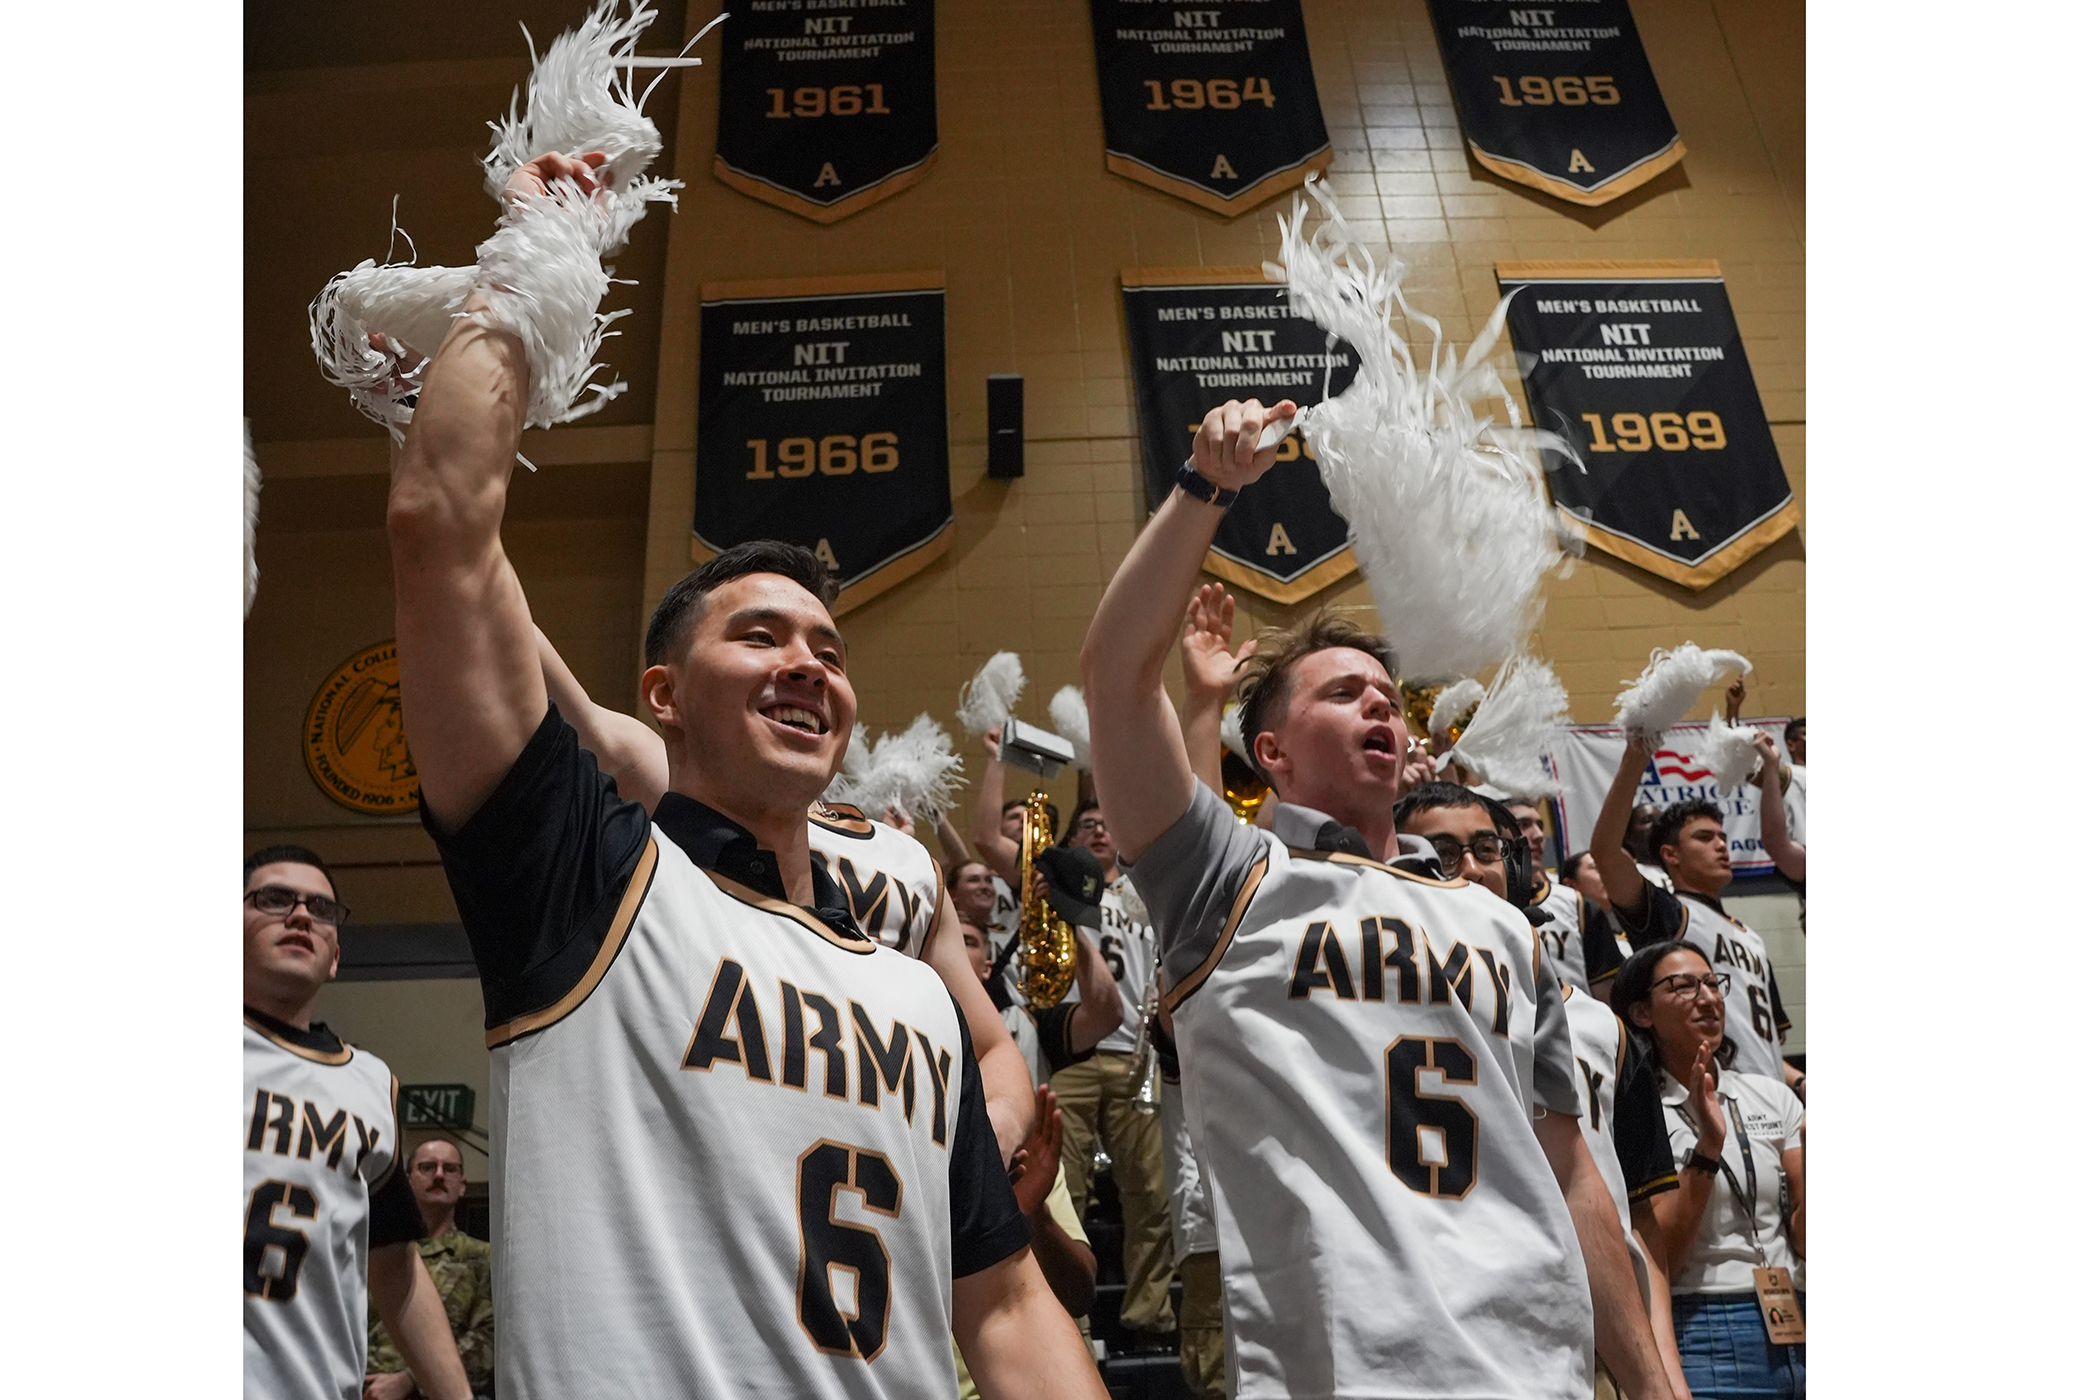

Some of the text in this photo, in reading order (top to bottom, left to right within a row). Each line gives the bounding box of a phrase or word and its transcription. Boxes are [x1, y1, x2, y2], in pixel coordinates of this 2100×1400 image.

[804, 16, 853, 35] NIT
[1173, 10, 1221, 28] NIT
[1508, 9, 1555, 27] NIT
[743, 31, 916, 50] NATIONAL INVITATION
[1116, 27, 1285, 41] NATIONAL INVITATION
[1457, 26, 1621, 39] NATIONAL INVITATION
[776, 46, 881, 62] TOURNAMENT
[1151, 40, 1254, 54] TOURNAMENT
[1492, 40, 1591, 51] TOURNAMENT
[765, 83, 890, 119] 1961
[1143, 77, 1275, 112] 1964
[1492, 75, 1621, 107] 1965
[1209, 153, 1238, 180] A
[1567, 148, 1596, 174] A
[813, 162, 841, 188] A
[1157, 304, 1302, 321] MEN'S BASKETB
[1537, 299, 1702, 314] MEN'S BASKETBALL
[733, 313, 912, 335] MEN'S BASKETBALL
[1600, 323, 1651, 346] NIT
[793, 341, 850, 366] NIT
[1221, 330, 1276, 353] NIT
[1156, 353, 1349, 372] NATIONAL INVITATION
[1541, 346, 1725, 364] NATIONAL INVITATION
[723, 363, 921, 386] NATIONAL INVITATION
[1195, 370, 1314, 388] TOURNAMENT
[1581, 363, 1692, 379] TOURNAMENT
[761, 382, 883, 402] TOURNAMENT
[1581, 411, 1728, 452] 1969
[745, 431, 899, 480] 1966
[1670, 508, 1700, 541] A
[1265, 522, 1297, 555] A
[814, 538, 840, 571] A
[310, 674, 351, 744] NATIONAL
[315, 753, 362, 800] FOUNDED
[1288, 915, 1510, 1040] ARMY
[1746, 984, 1773, 1043] 6
[680, 956, 953, 1150] ARMY
[406, 1089, 460, 1123] EXIT
[1383, 1034, 1479, 1201] 6
[243, 1179, 320, 1303] 6
[796, 1137, 903, 1366] 6
